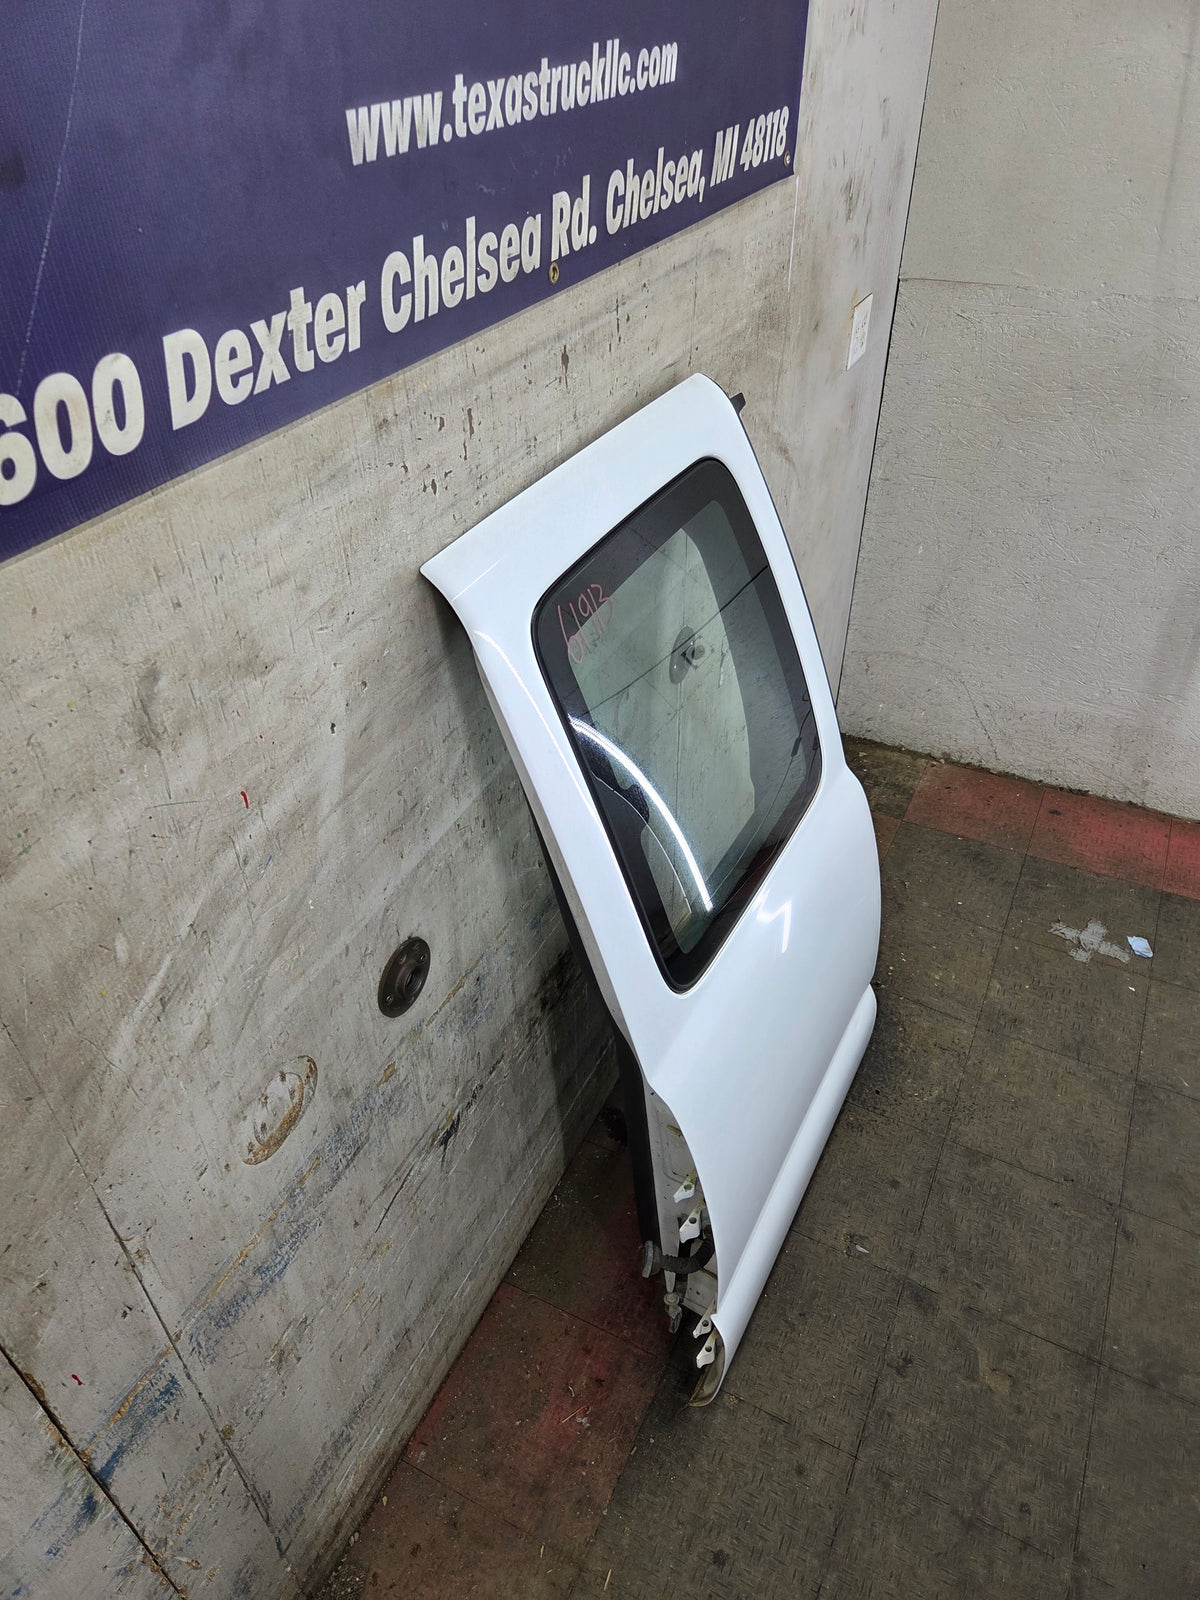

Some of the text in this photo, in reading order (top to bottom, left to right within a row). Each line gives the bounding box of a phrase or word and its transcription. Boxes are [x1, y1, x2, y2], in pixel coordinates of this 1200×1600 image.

[345, 38, 678, 166] www.texastruckllc.com
[0, 105, 790, 506] 600 Dexter Chelsea Rd. Chelsea, MI 48118
